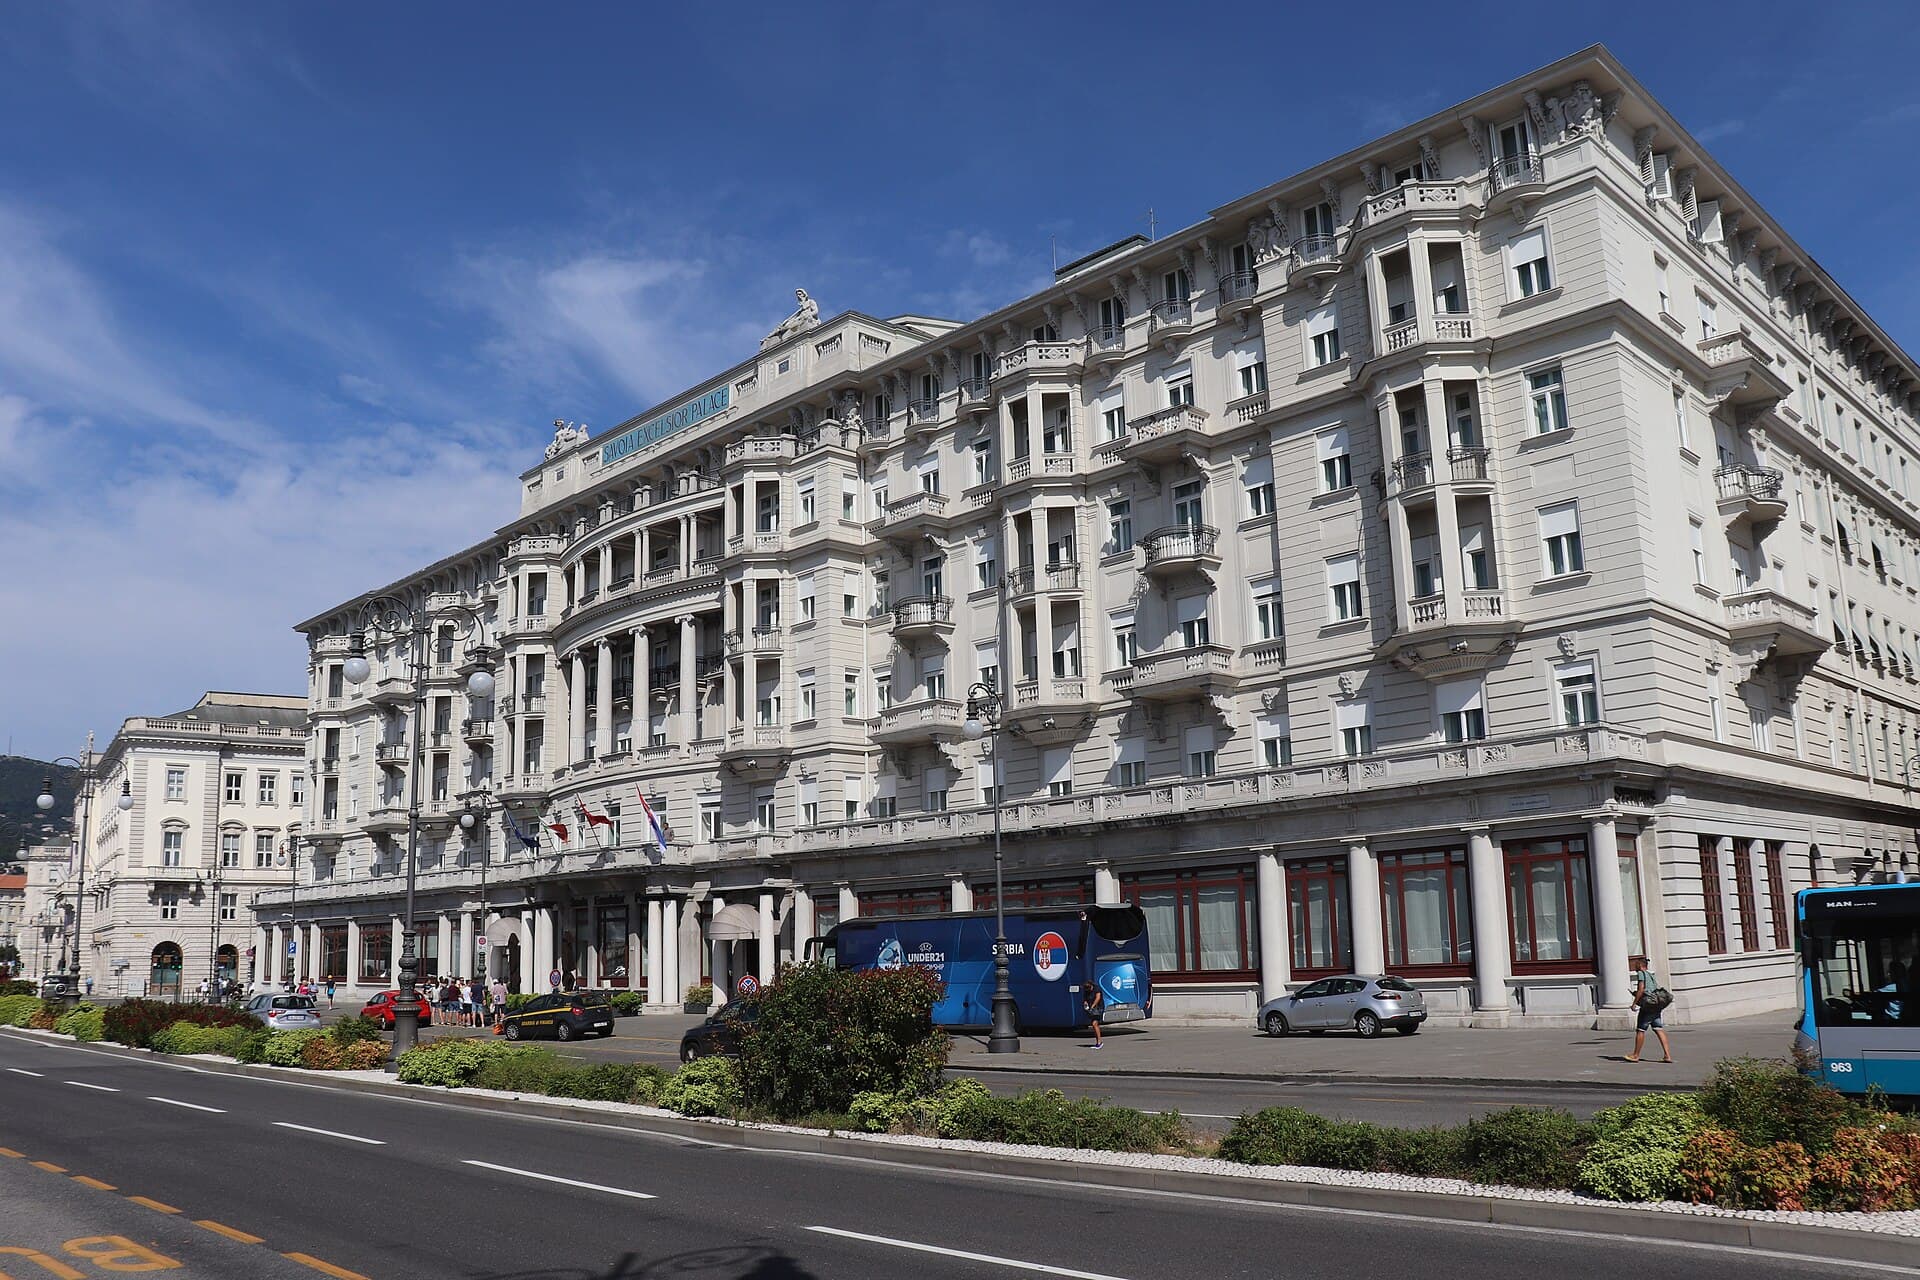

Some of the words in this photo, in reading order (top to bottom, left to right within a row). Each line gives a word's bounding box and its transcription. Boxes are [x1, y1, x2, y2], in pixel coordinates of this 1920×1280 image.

[604, 434, 634, 463] SAVOIA
[636, 406, 688, 447] EXCELSIOR
[691, 386, 728, 421] PALACE
[1826, 900, 1852, 908] MAN
[992, 943, 1025, 955] SRBIA
[907, 952, 945, 963] UNDER21
[1830, 1062, 1853, 1073] 963
